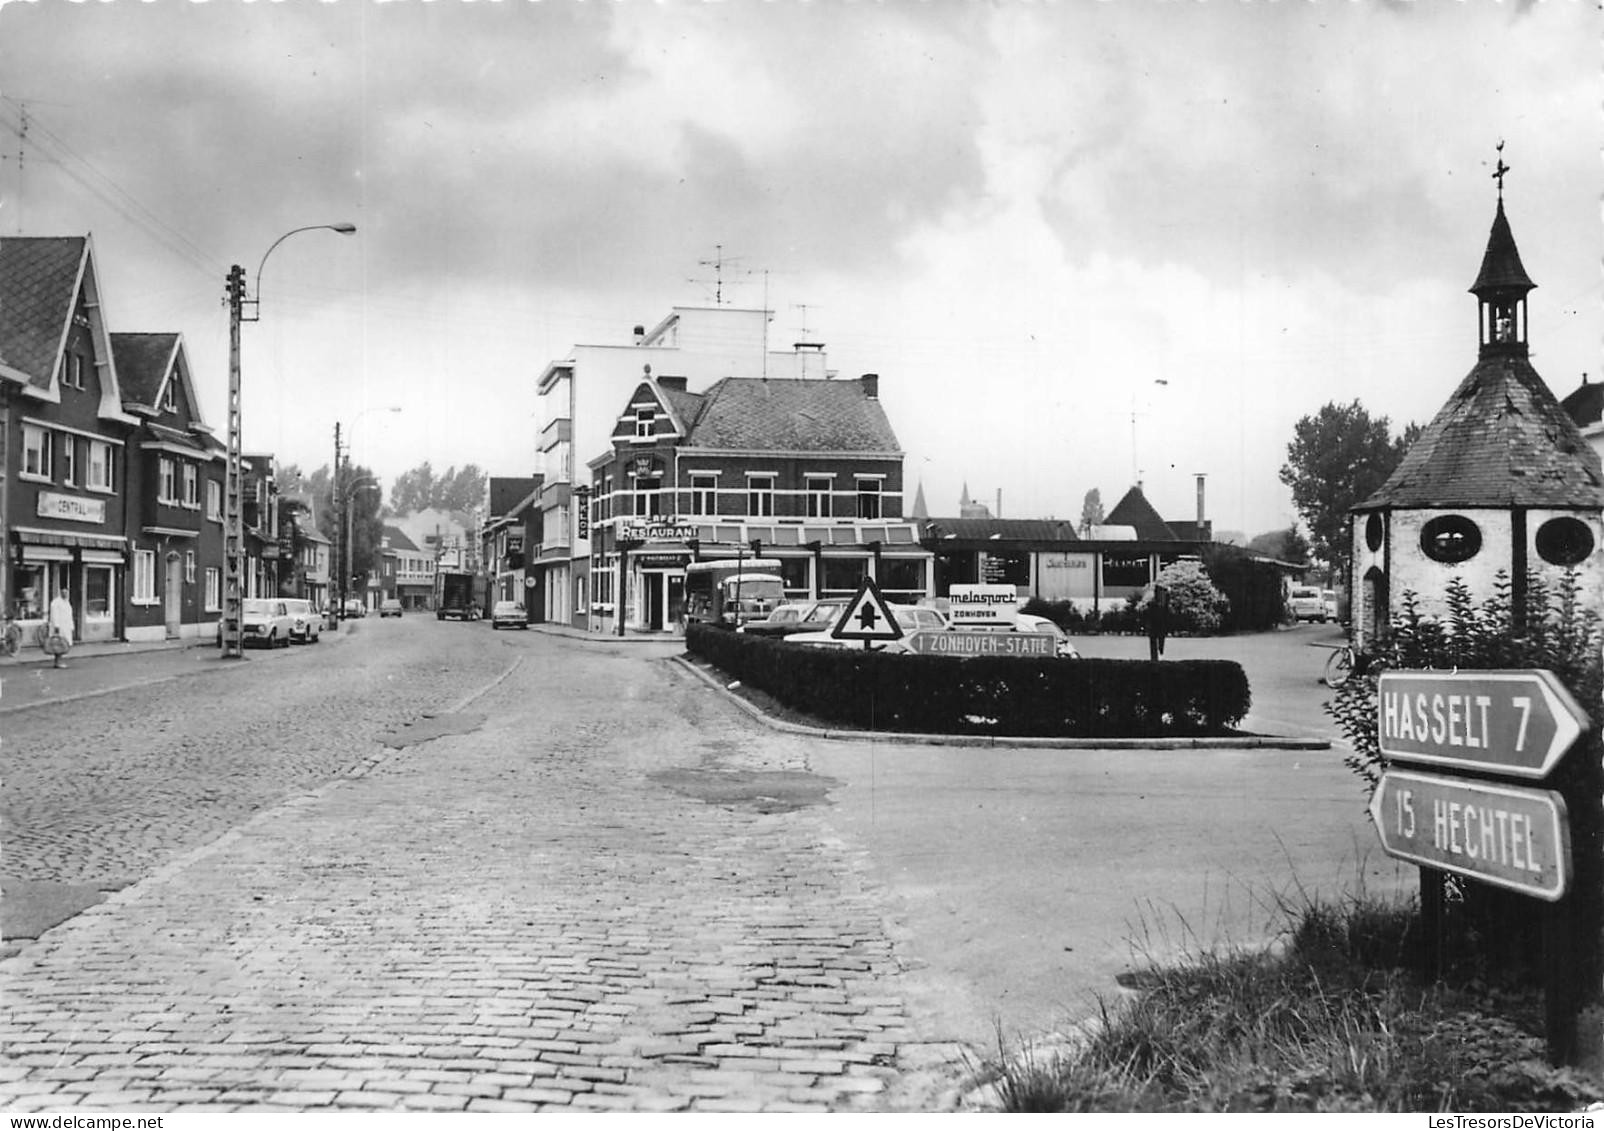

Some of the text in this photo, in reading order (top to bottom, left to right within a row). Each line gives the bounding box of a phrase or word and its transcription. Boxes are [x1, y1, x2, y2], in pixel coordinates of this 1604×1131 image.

[622, 526, 697, 539] RESTAURANT
[954, 610, 997, 618] ZONHOVEN
[930, 635, 1048, 654] ZONHOVEN-STATIE
[1384, 691, 1531, 752] HASSELT 7
[1396, 790, 1542, 873] 15 HECHTEL
